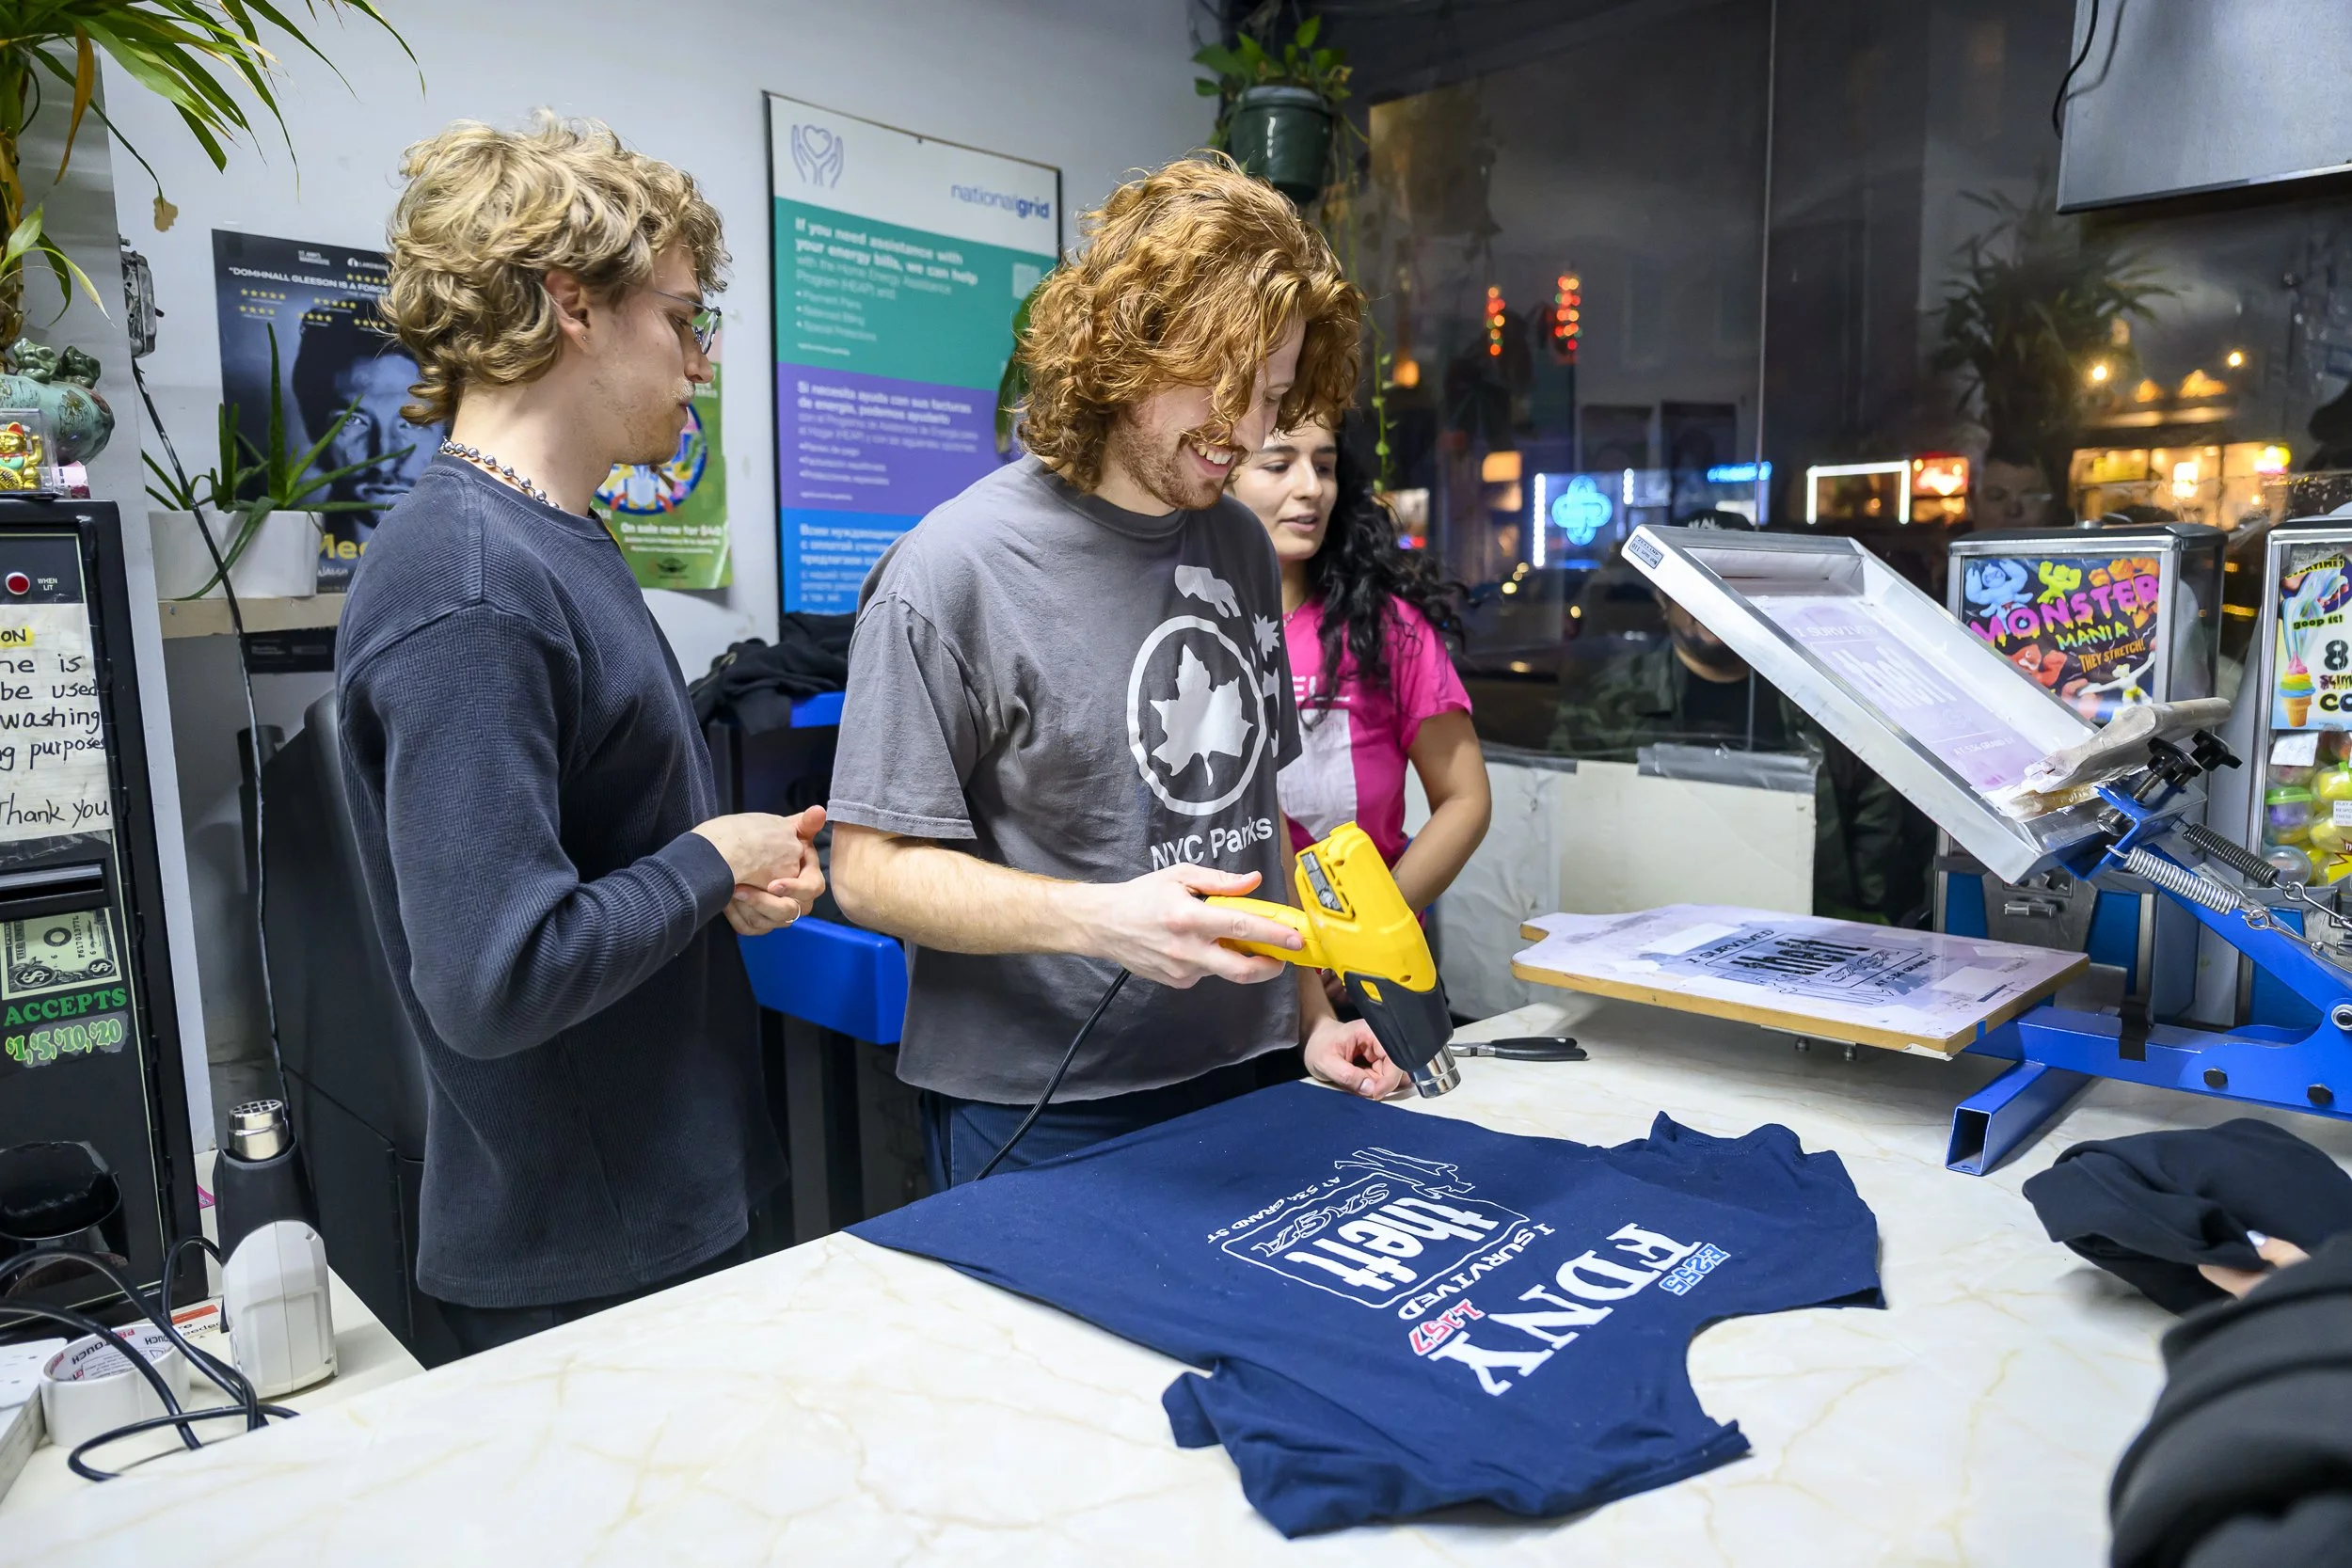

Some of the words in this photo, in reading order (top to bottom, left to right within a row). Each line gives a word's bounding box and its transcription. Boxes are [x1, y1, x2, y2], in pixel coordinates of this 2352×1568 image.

[291, 274, 337, 289] GLEESON
[338, 280, 348, 290] IS
[1970, 575, 2159, 648] MONSTER
[2055, 621, 2130, 651] MANIA
[57, 654, 86, 673] is
[2078, 651, 2103, 673] THEY
[2103, 639, 2146, 661] STRETCH!
[2324, 640, 2349, 671] 8
[1, 681, 33, 701] be
[52, 678, 98, 699] used
[0, 706, 100, 735] washing
[30, 736, 105, 770] purposes
[1151, 834, 1204, 871] NYC
[1210, 816, 1273, 859] Parks
[1699, 929, 1775, 958] SURVIVED
[4, 989, 127, 1027] ACCEPTS
[1322, 1177, 1341, 1188] AT
[1231, 1198, 1285, 1229] GRAND
[1250, 1182, 1390, 1258] SAGA
[1533, 1223, 1556, 1236] I
[1208, 1228, 1230, 1243] ST
[1283, 1197, 1500, 1292] theft
[1398, 1228, 1535, 1321] SURVIVED
[1659, 1243, 1731, 1296] E255
[1427, 1223, 1703, 1397] FDNY
[1408, 1298, 1486, 1356] L157
